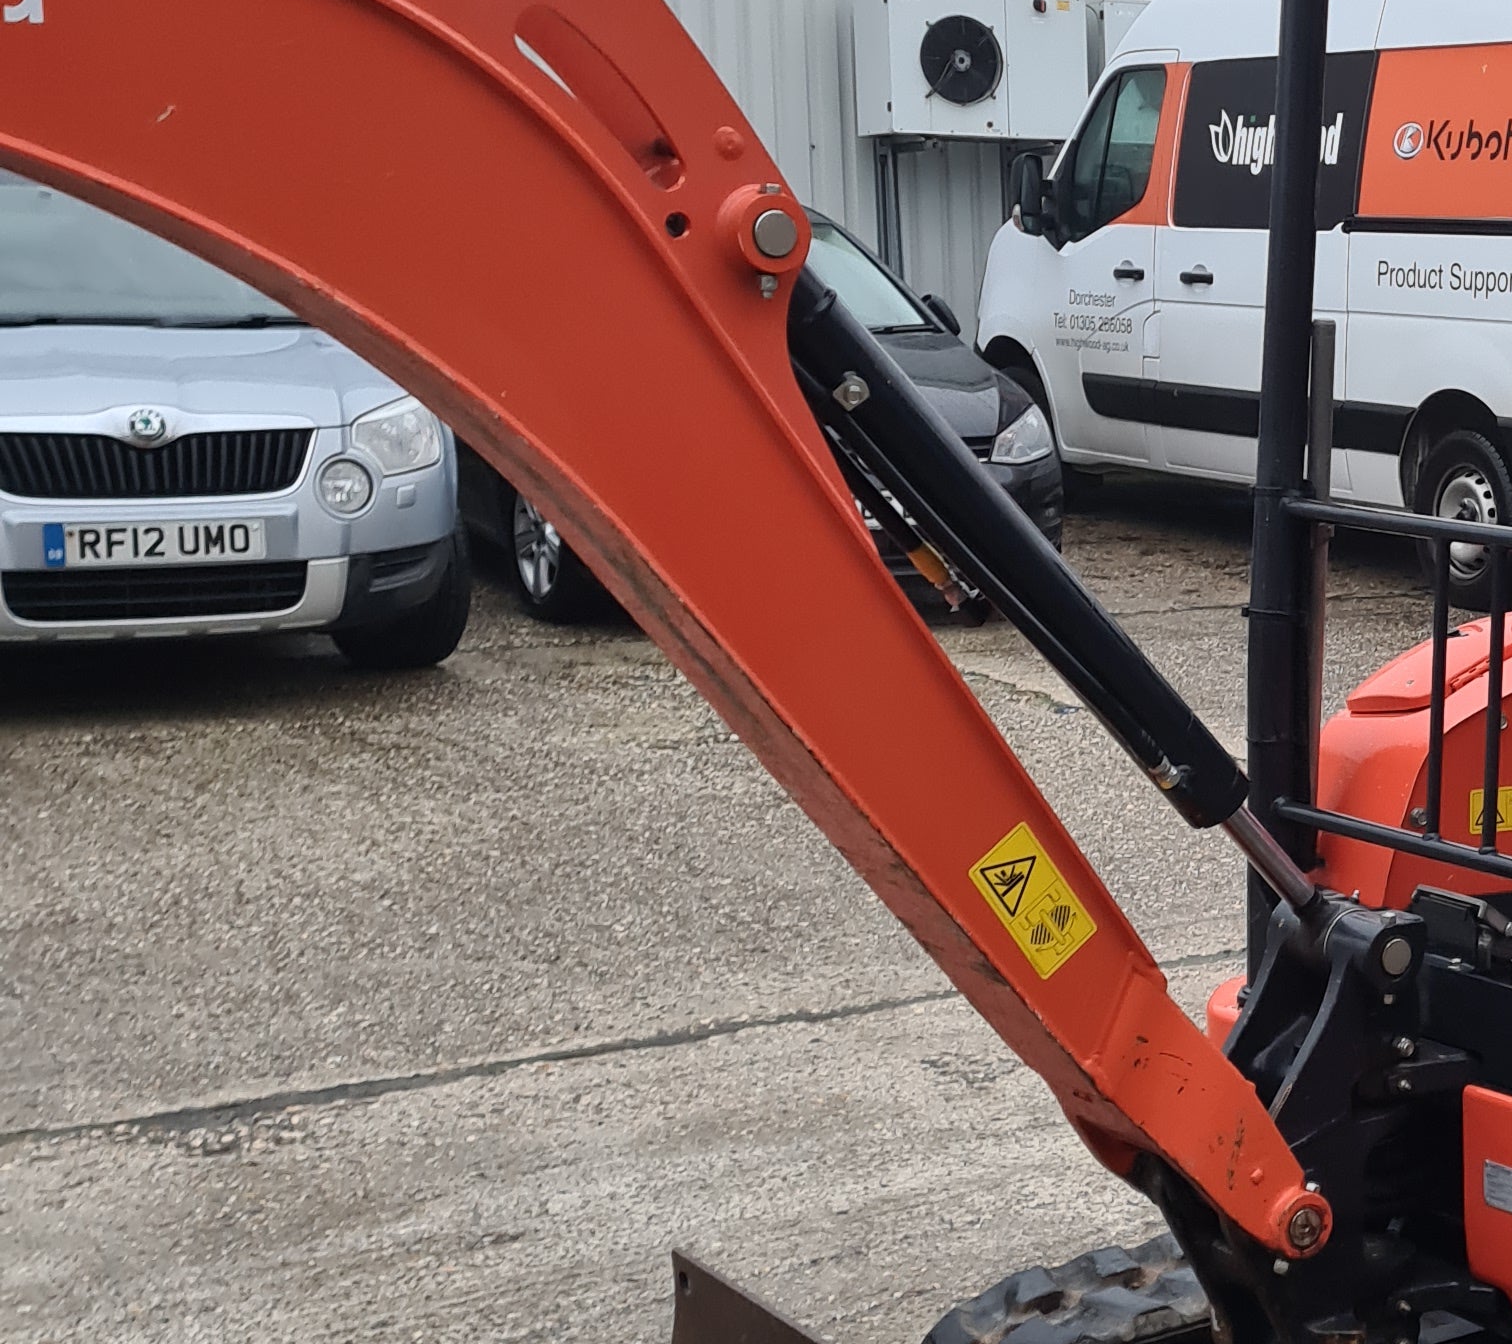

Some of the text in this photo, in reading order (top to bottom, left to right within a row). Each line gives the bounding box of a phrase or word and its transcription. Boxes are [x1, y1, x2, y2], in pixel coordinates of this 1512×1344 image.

[1377, 260, 1444, 290] Product
[1068, 289, 1116, 308] Dorchester
[1069, 314, 1096, 331] 01305
[78, 523, 250, 559] RF12 UMO
